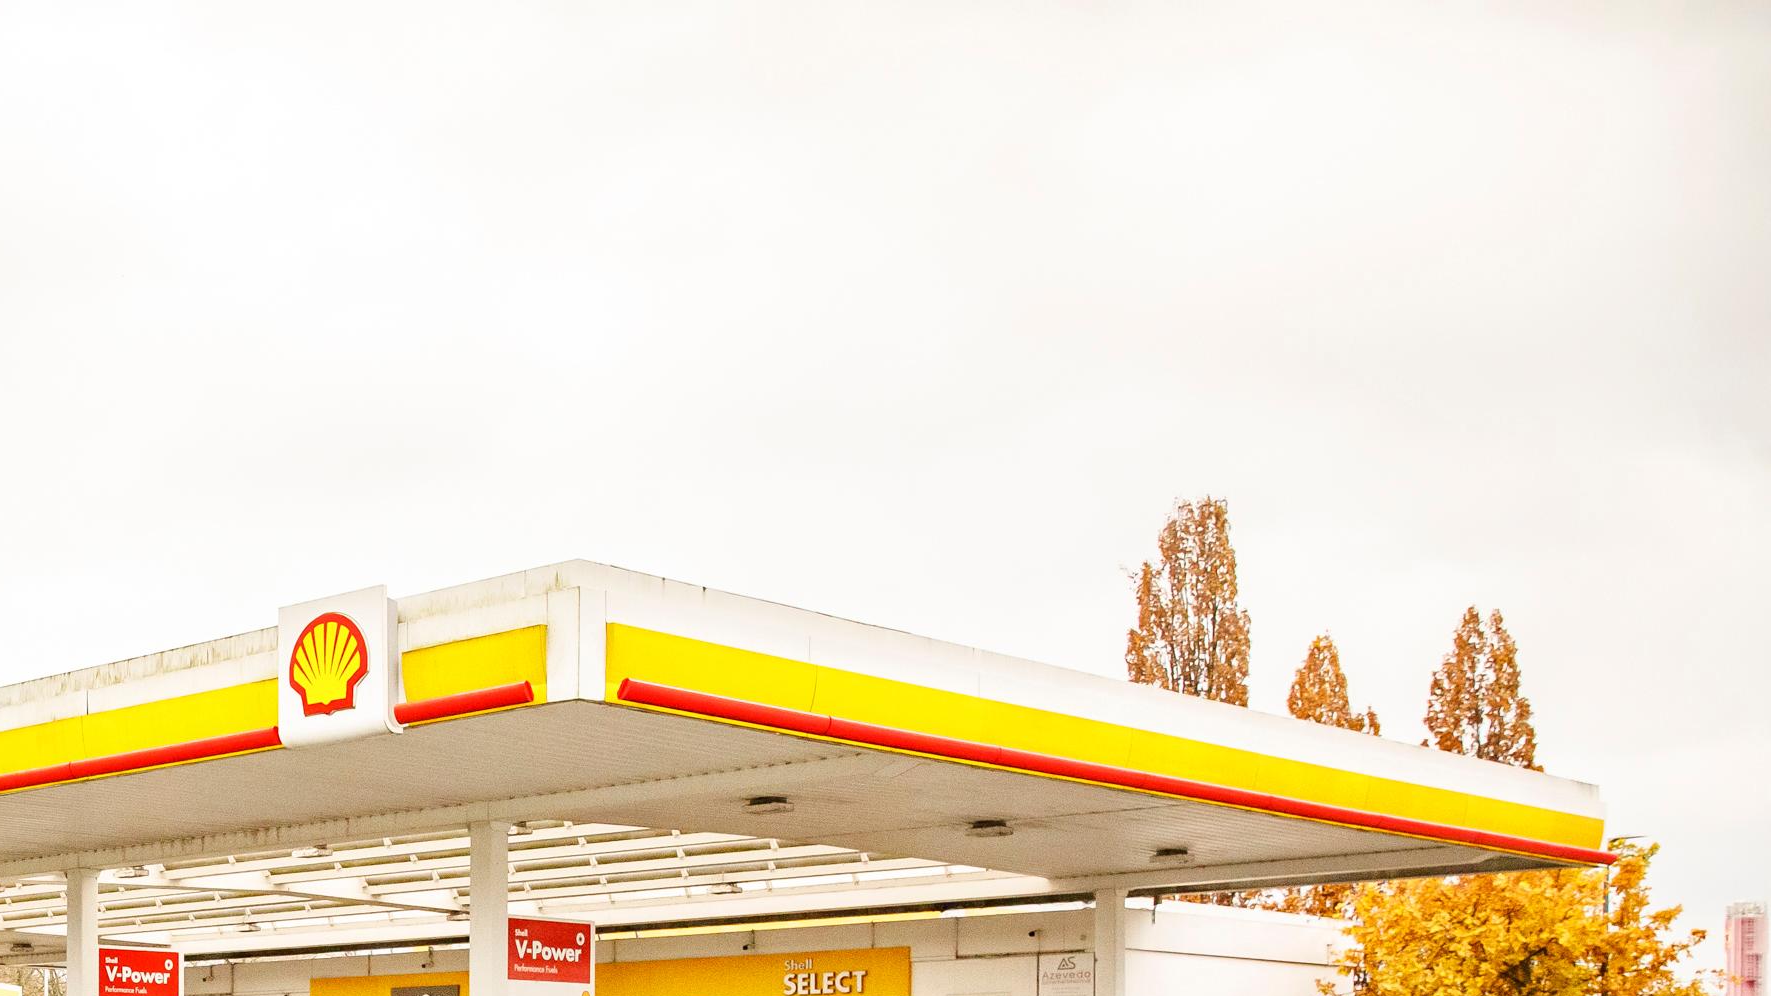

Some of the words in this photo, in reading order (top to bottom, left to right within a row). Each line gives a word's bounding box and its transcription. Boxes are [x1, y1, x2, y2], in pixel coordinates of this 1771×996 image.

[514, 929, 528, 937] Shell
[514, 938, 582, 963] V-Power
[104, 956, 118, 964] Shell
[784, 958, 813, 971] Shell
[514, 964, 545, 974] Performance
[545, 965, 558, 974] Fuels
[104, 965, 171, 985] V-Power
[1041, 970, 1092, 980] Azevedo
[783, 970, 868, 996] SELECT
[104, 985, 134, 994] Performance
